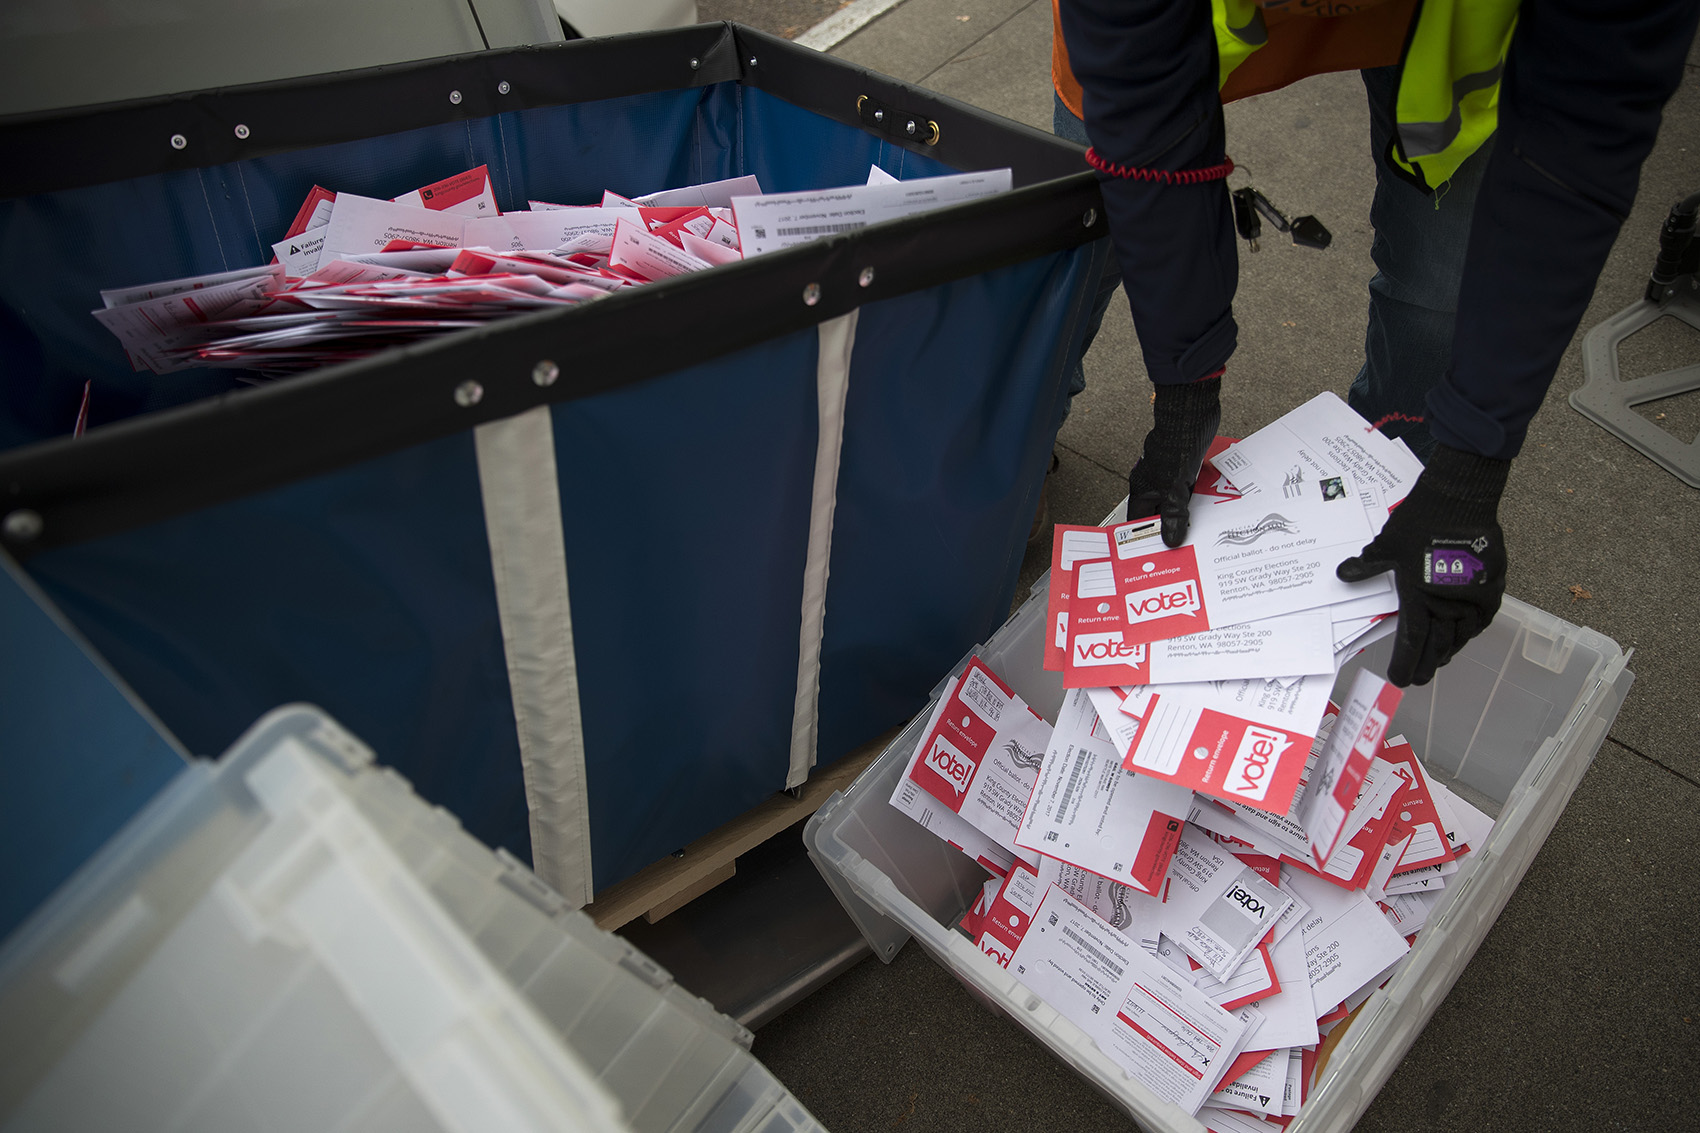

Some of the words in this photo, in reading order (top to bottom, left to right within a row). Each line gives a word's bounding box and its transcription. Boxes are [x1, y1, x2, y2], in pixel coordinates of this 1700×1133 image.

[1322, 436, 1335, 446] 200
[1298, 449, 1312, 463] delay
[1310, 460, 1321, 470] not
[1320, 469, 1328, 477] do
[1214, 553, 1240, 564] Official
[1241, 548, 1263, 558] ballot
[1281, 542, 1294, 550] not
[1296, 538, 1317, 546] delay
[1124, 574, 1148, 584] Return
[1149, 566, 1180, 578] envelope
[1216, 570, 1234, 580] King
[1235, 566, 1262, 577] County
[1264, 559, 1299, 571] Elections
[1218, 580, 1234, 588] 919
[1234, 577, 1248, 585] SW
[1248, 572, 1272, 584] Grady
[1273, 568, 1290, 578] Way
[1291, 565, 1304, 573] Ste
[1306, 562, 1320, 570] 200
[1220, 586, 1250, 596] Renton,
[1252, 581, 1264, 589] WA
[1268, 571, 1314, 586] 98057-2905
[1129, 585, 1194, 616] vote!
[1168, 642, 1196, 652] Renton,
[1217, 638, 1264, 648] 98057-2905
[1198, 633, 1222, 642] Grady
[1224, 632, 1242, 640] Way
[1258, 690, 1271, 708] King
[1268, 697, 1277, 710] 919
[1278, 687, 1293, 713] Renton
[946, 718, 960, 734] Return
[958, 728, 978, 748] envelope
[1064, 744, 1074, 763] Election
[1202, 760, 1216, 784] Return
[1214, 730, 1229, 761] envelope
[1236, 731, 1278, 791] vote!
[931, 744, 972, 786] vote!
[993, 758, 1010, 774] Official
[1008, 768, 1022, 782] ballot
[1022, 781, 1030, 790] do
[986, 774, 998, 788] King
[996, 781, 1013, 800] County
[1011, 793, 1028, 808] Electio
[1050, 775, 1062, 799] November
[1105, 786, 1115, 805] opened
[980, 790, 997, 806] Renton,
[996, 802, 1006, 812] WA
[1006, 810, 1022, 822] 98057
[983, 782, 994, 792] 919
[992, 788, 1001, 798] SW
[998, 794, 1014, 808] Grady
[1012, 804, 1024, 816] Way
[1402, 799, 1424, 808] Return
[1241, 804, 1256, 814] date
[1255, 811, 1268, 820] and
[1097, 814, 1105, 828] voted
[1267, 817, 1281, 828] sign
[1175, 846, 1195, 863] Grady
[1188, 847, 1200, 858] WA
[1210, 854, 1224, 867] USA
[1175, 855, 1198, 875] County
[1191, 859, 1203, 870] SW
[1198, 854, 1219, 872] Renton
[1201, 866, 1214, 878] 919
[1062, 877, 1069, 889] WA
[1076, 870, 1087, 894] County
[1180, 875, 1201, 893] Official
[1193, 869, 1210, 884] King
[1069, 877, 1078, 896] Grad
[1094, 880, 1103, 900] ballot
[1225, 883, 1268, 920] vote!
[990, 916, 1009, 931] Return
[1006, 927, 1023, 941] envel
[1069, 918, 1080, 928] 2017
[1306, 916, 1323, 932] delay
[1083, 929, 1103, 946] November
[976, 940, 1012, 969] vot
[1112, 951, 1129, 965] Election
[1316, 951, 1328, 960] Ste
[1326, 940, 1340, 952] 200
[1052, 963, 1064, 974] voted
[1308, 952, 1340, 980] 8057-2905
[1062, 971, 1072, 980] and
[1095, 995, 1106, 1005] Only
[1202, 1057, 1211, 1066] X
[1234, 1088, 1258, 1101] Failure
